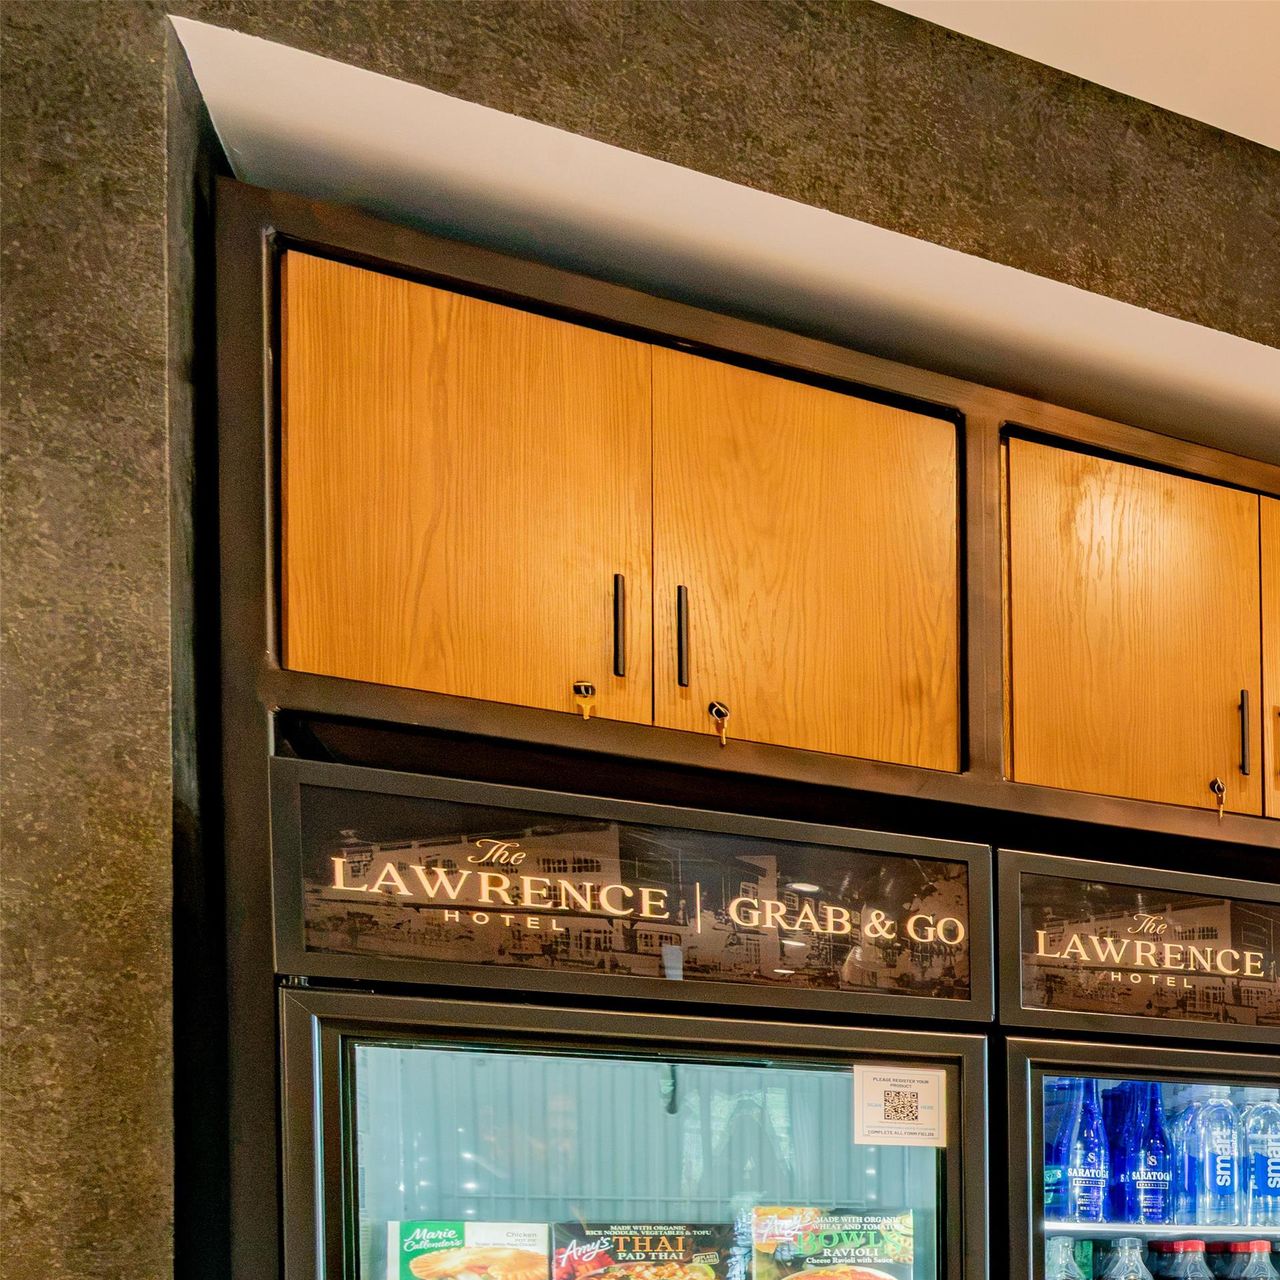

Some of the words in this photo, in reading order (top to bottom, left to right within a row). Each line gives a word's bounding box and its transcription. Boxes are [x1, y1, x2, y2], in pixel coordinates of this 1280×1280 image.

[468, 839, 526, 865] The
[331, 857, 670, 919] LAWRENCE
[728, 897, 851, 935] GRAB
[864, 910, 896, 939] &
[907, 914, 965, 944] GO
[444, 910, 564, 931] HOTEL
[1127, 913, 1167, 935] The
[1036, 929, 1264, 977] LAWRENCE
[1111, 972, 1192, 989] HOTEL
[1216, 1128, 1231, 1187] smart
[864, 1216, 902, 1224] ORGANIC
[404, 1228, 457, 1241] Marie
[795, 1231, 903, 1256] BOWLS
[559, 1236, 612, 1267] Amy's
[612, 1236, 685, 1252] THAI
[618, 1252, 645, 1260] PAD
[650, 1252, 684, 1260] THAI
[823, 1248, 878, 1257] RAVIOLI
